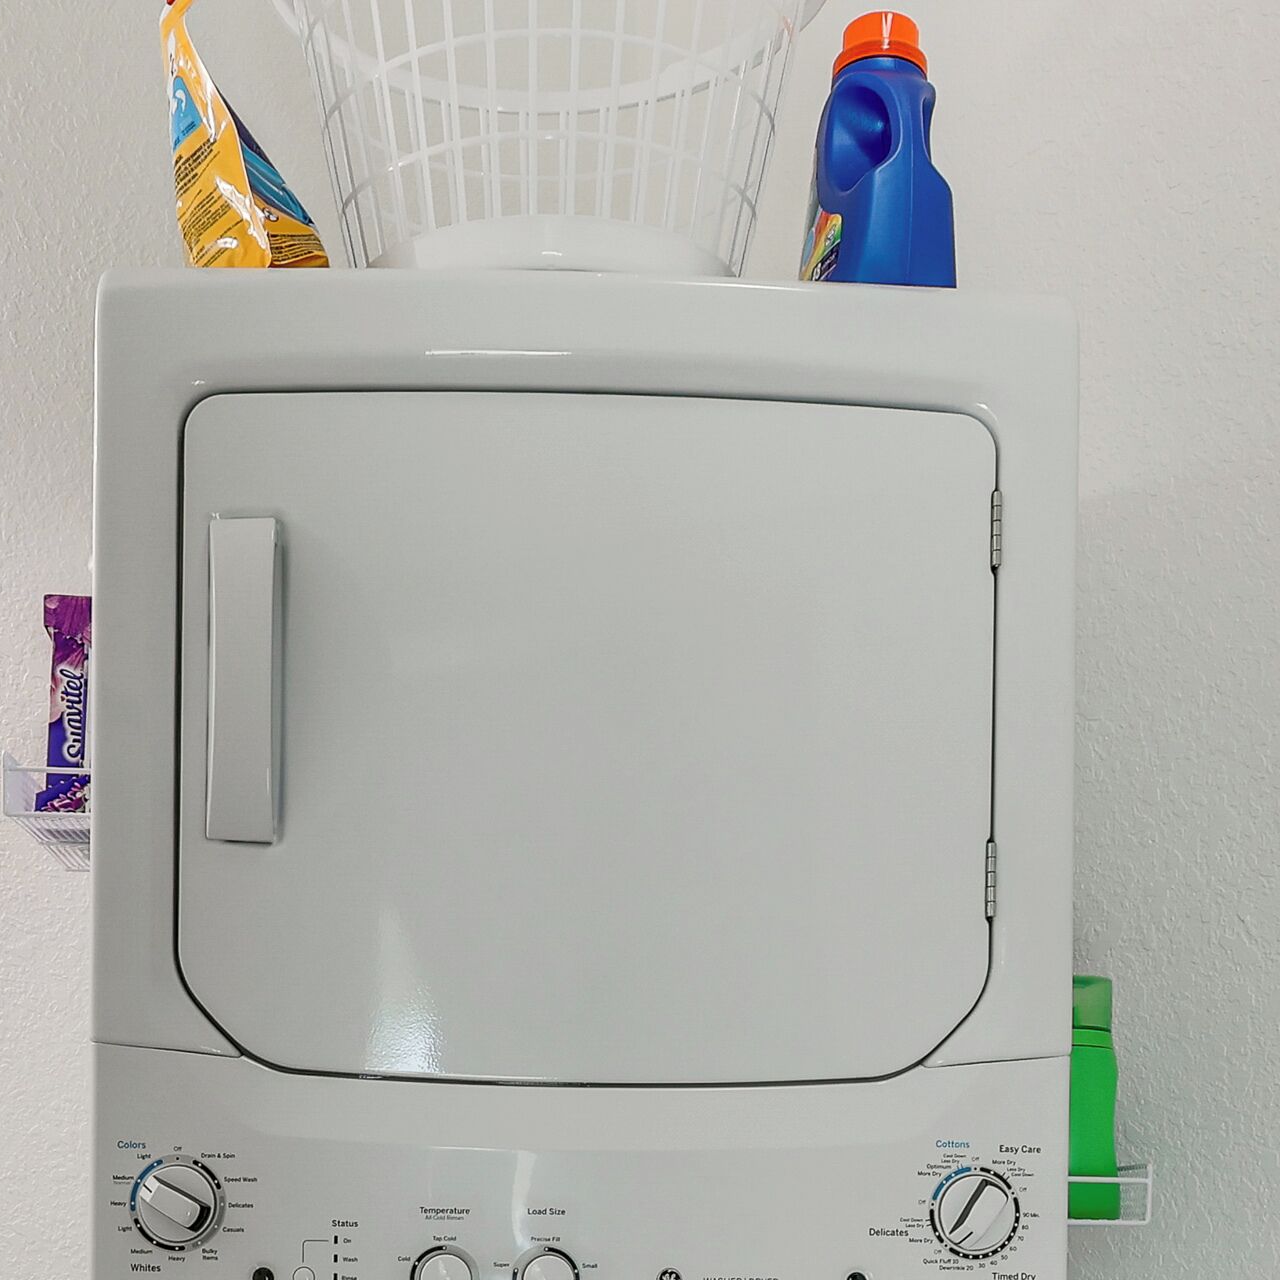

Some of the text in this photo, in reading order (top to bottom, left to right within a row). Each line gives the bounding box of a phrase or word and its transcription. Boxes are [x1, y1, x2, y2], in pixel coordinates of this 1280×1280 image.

[60, 669, 84, 758] Suavitel
[117, 1141, 146, 1149] Colors
[936, 1140, 970, 1148] Cottons
[999, 1145, 1041, 1155] Easy Care
[420, 1207, 470, 1216] Temperature
[528, 1208, 566, 1216] Load Size
[332, 1220, 358, 1228] Status
[869, 1228, 909, 1237] Delicates
[130, 1264, 161, 1272] Whites
